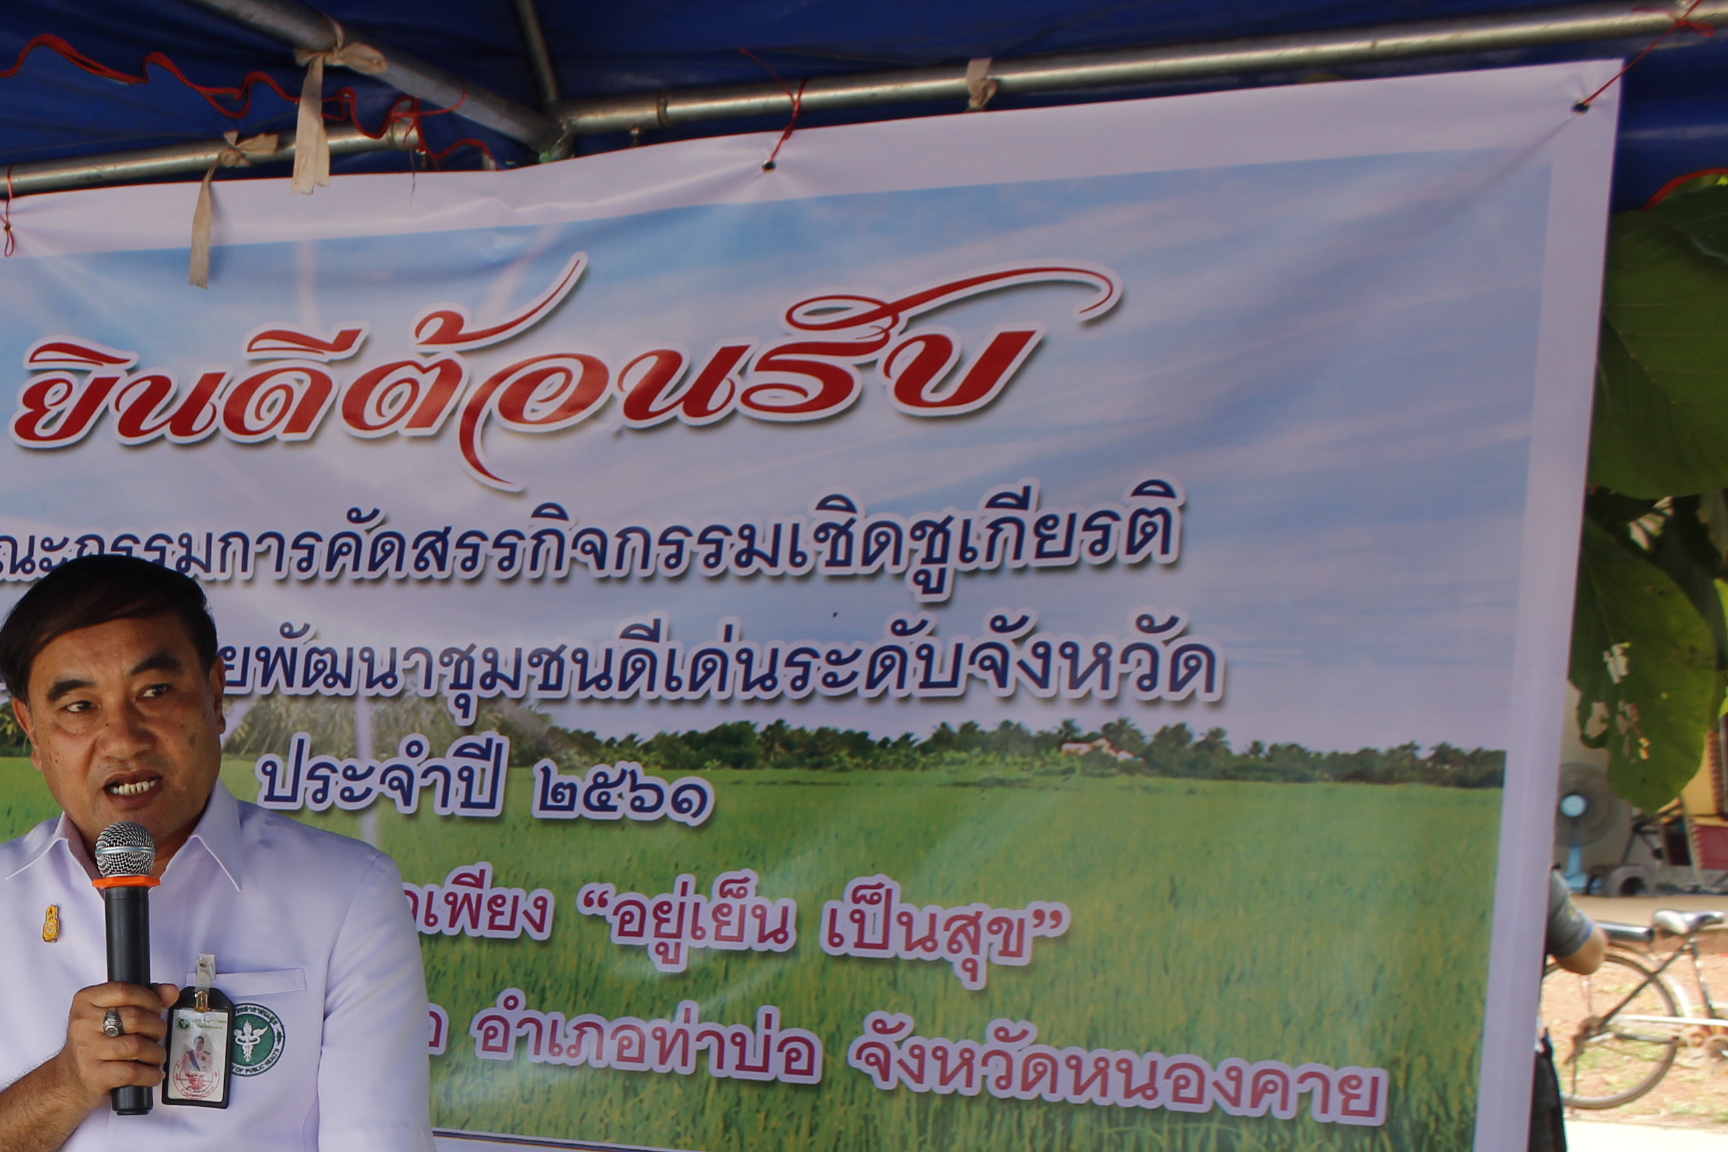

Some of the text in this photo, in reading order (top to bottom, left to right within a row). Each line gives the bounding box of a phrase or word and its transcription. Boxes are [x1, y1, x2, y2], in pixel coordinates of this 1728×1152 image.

[15, 254, 1114, 484] ยินดีต้อนรับ
[259, 738, 709, 820] ประจำปี ๒๕๖๑
[477, 994, 816, 1078] อำเภอท่าบ่อ
[855, 1017, 1380, 1119] จังหวัดหนองคาย
